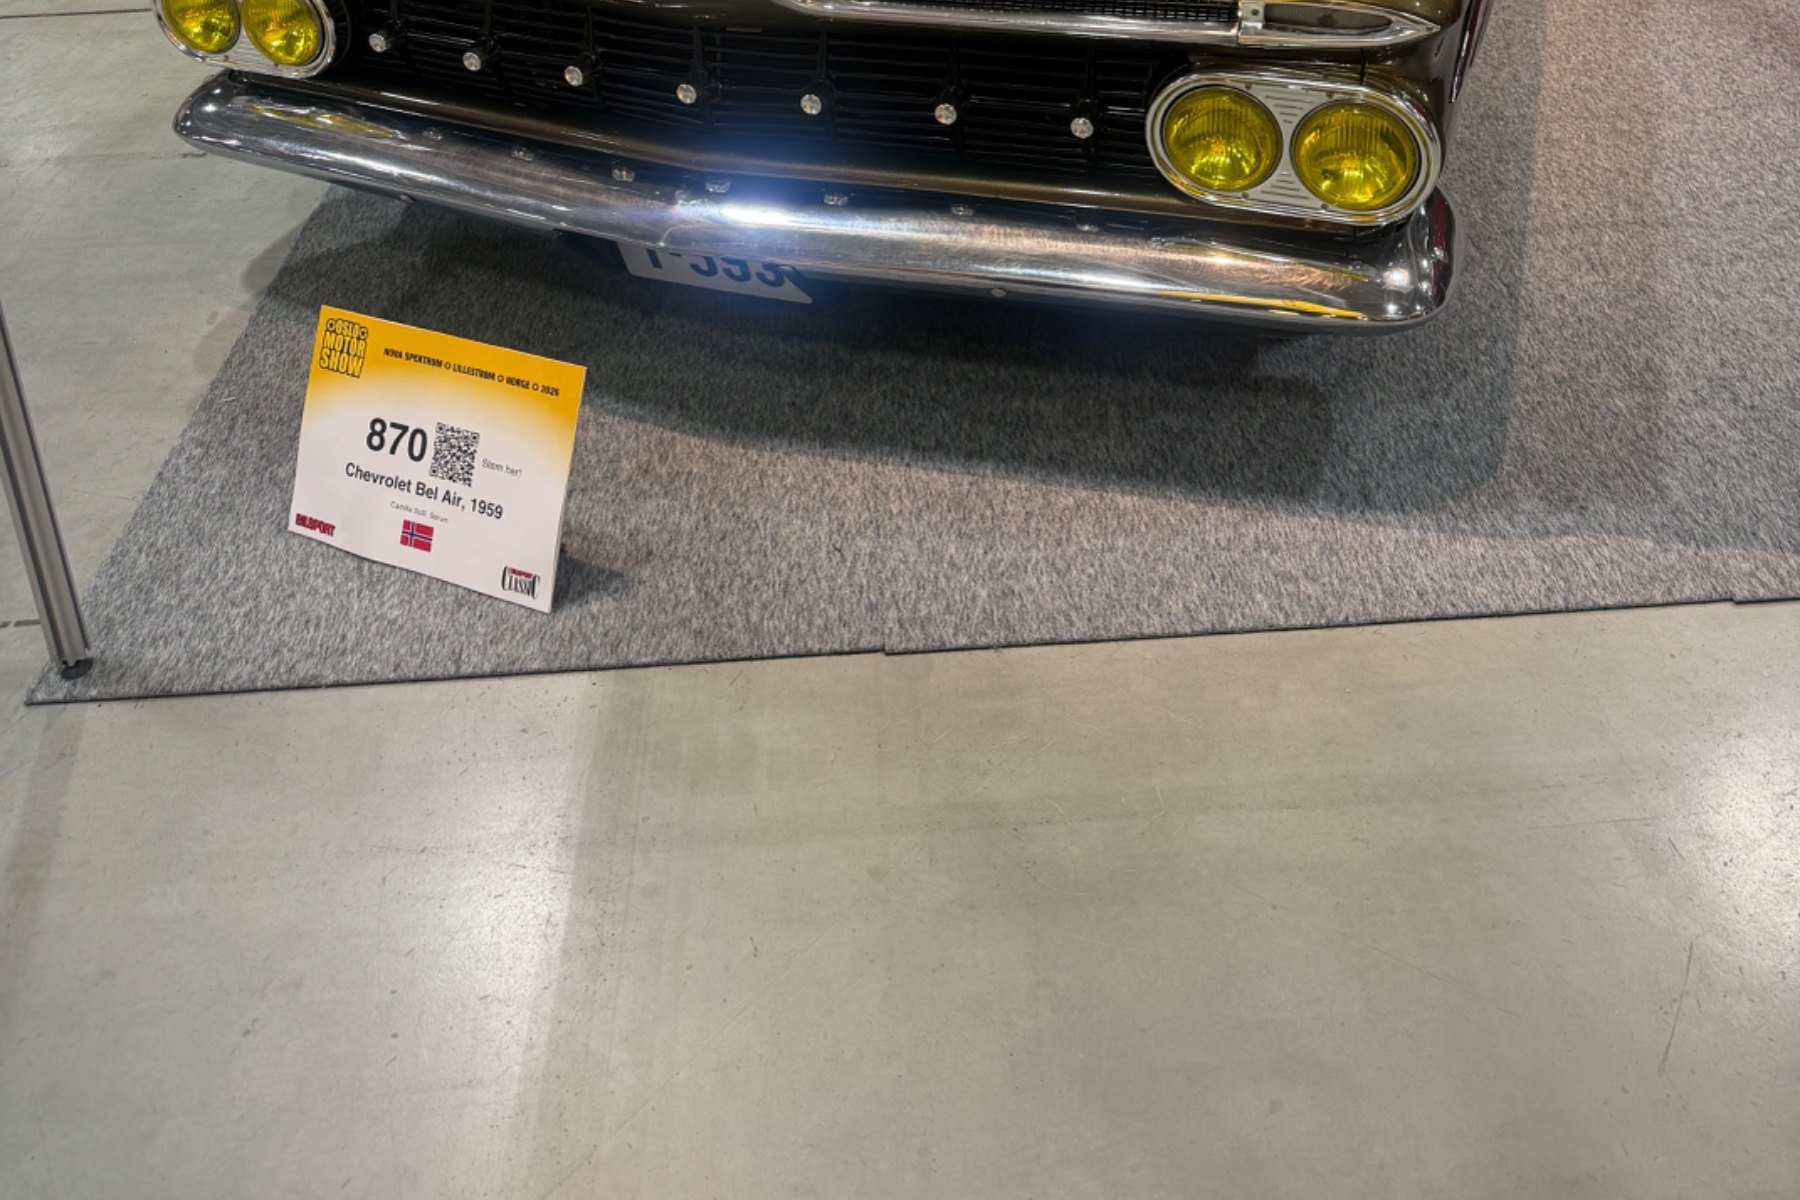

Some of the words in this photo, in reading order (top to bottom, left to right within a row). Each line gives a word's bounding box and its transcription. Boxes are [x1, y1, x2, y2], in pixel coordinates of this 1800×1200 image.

[335, 319, 361, 338] OSLO
[323, 330, 367, 358] MOTOR
[319, 347, 364, 379] SHOW
[384, 348, 403, 360] NOVA
[405, 352, 443, 368] SPEKTRUM
[506, 376, 531, 390] NORGE
[541, 385, 560, 397] 2026
[366, 417, 428, 462] 870
[482, 458, 503, 474] Stem
[345, 462, 412, 494] Chevrolet
[415, 481, 438, 501] Bel
[442, 490, 466, 511] Air,
[471, 497, 503, 520] 1959
[295, 513, 336, 537] BILSPORT
